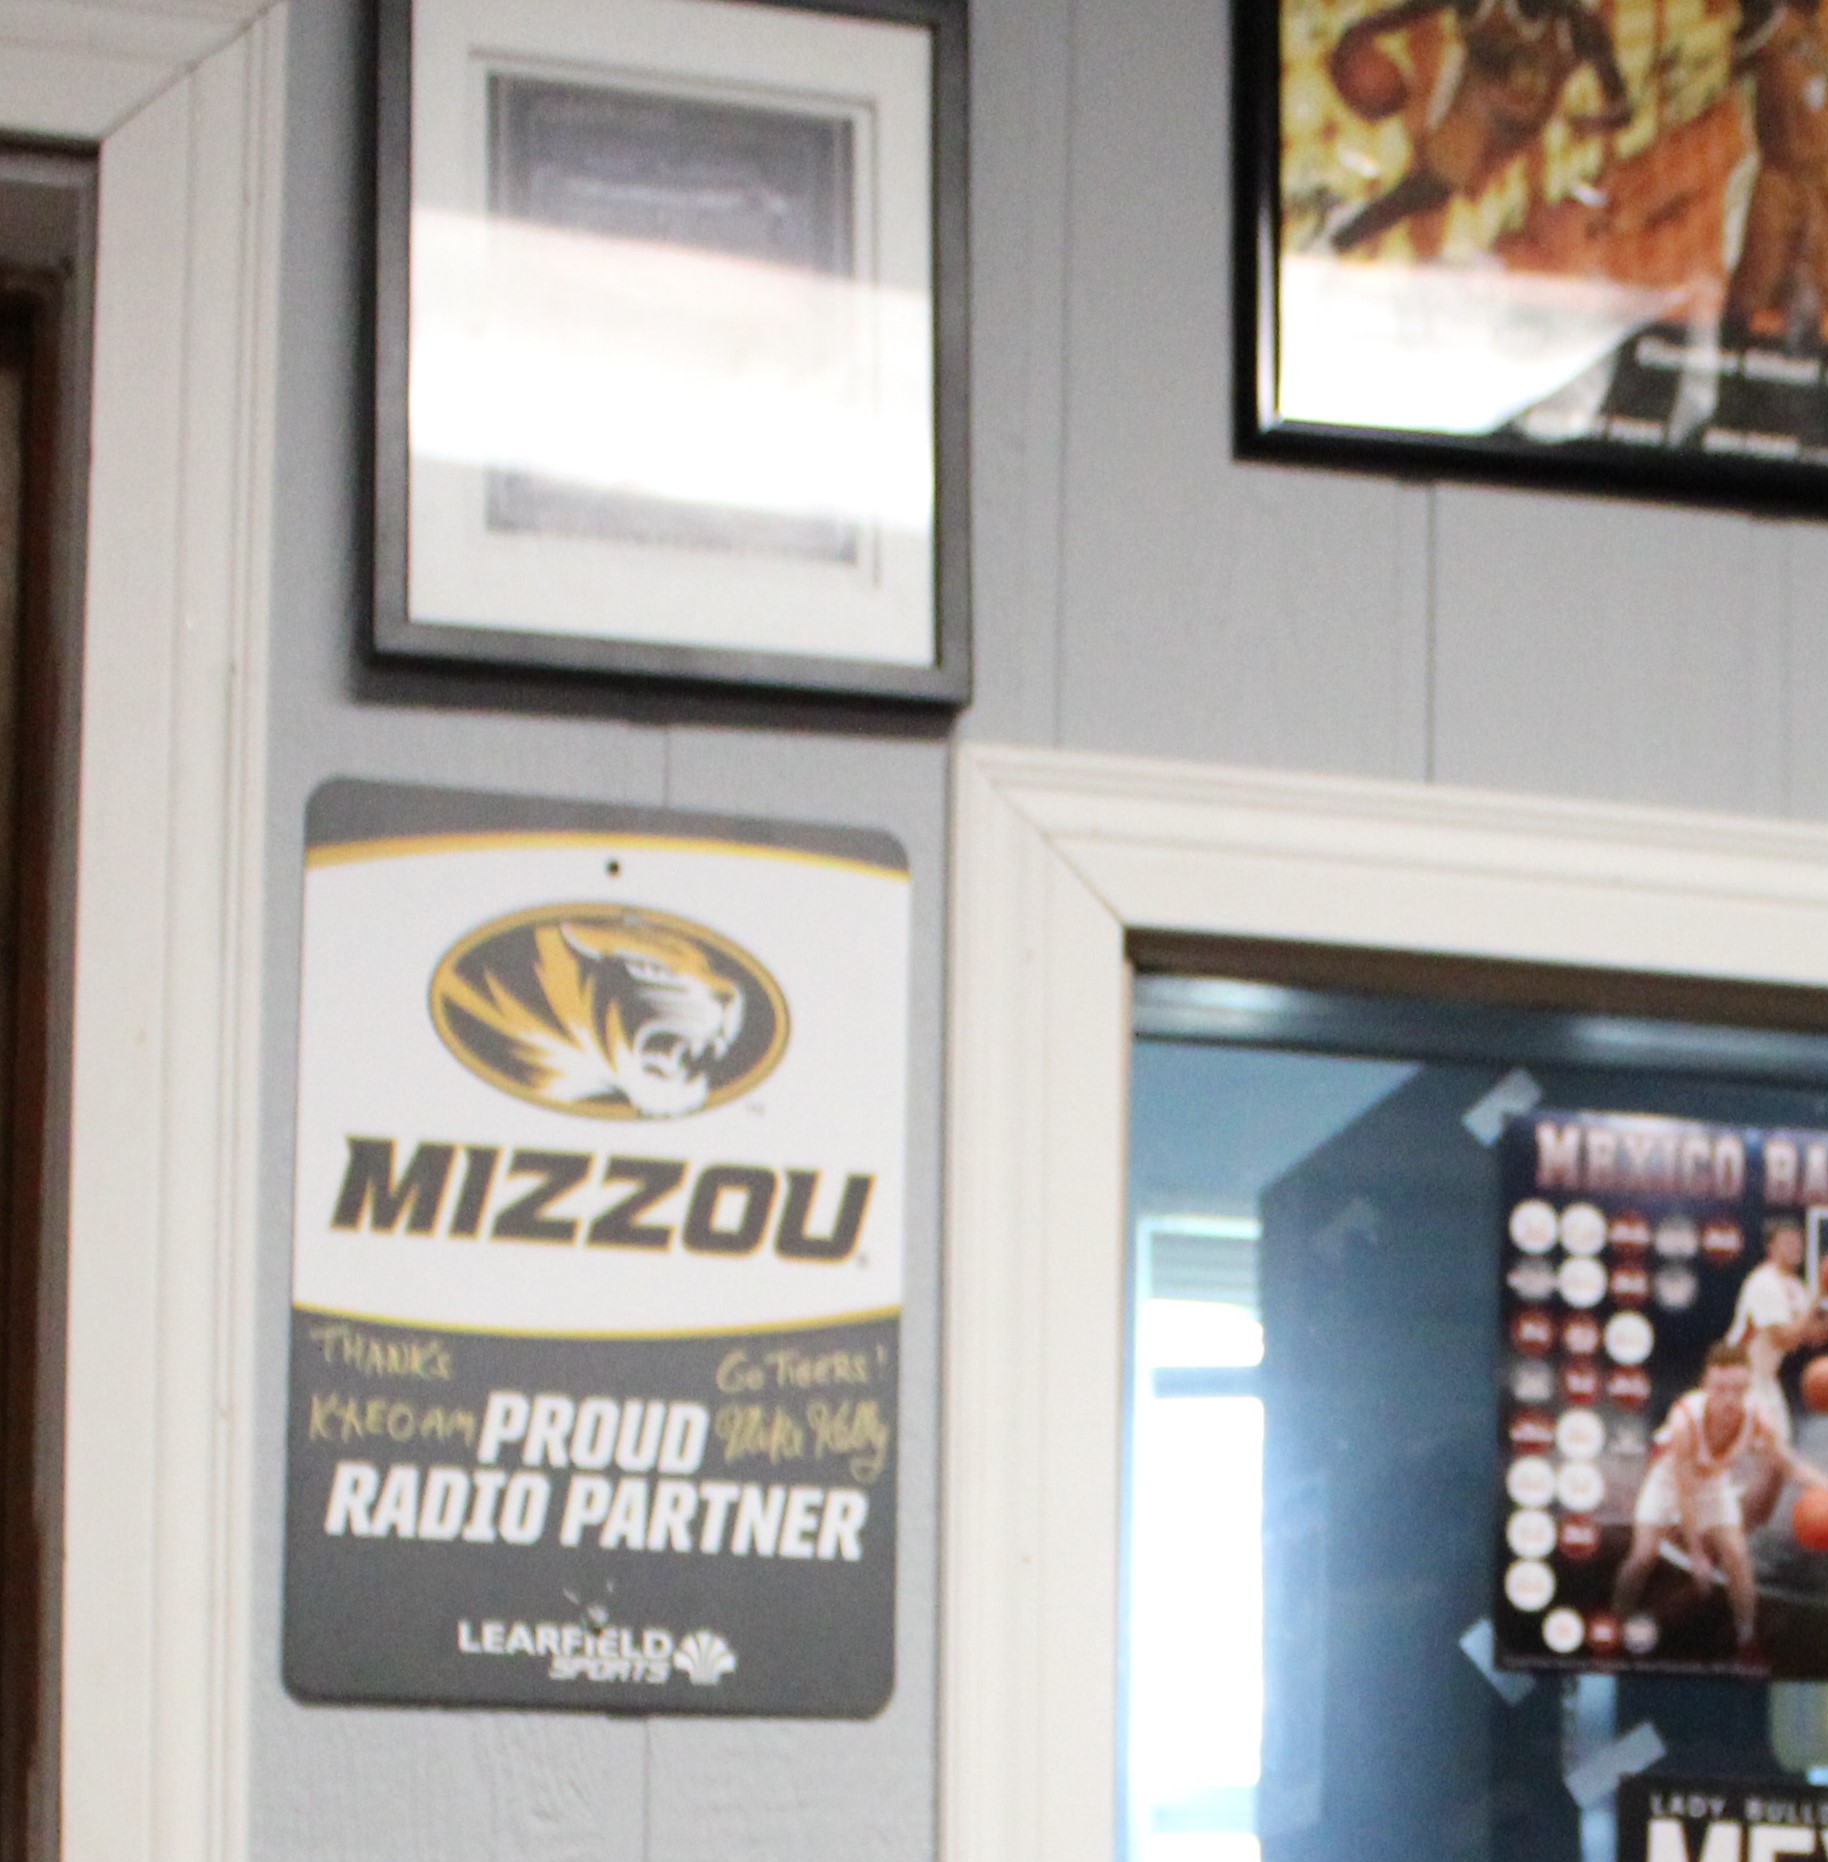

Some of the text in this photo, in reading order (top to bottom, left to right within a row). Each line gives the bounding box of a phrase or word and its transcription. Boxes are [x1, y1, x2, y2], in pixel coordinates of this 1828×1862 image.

[1534, 1120, 1746, 1198] MEXICO
[330, 1134, 878, 1264] MIZZOU
[478, 1389, 709, 1475] PROUD
[324, 1461, 868, 1563] RADIO PARTNER
[457, 1619, 675, 1659] LEARFIELD
[548, 1655, 673, 1685] SPORTS
[1650, 1794, 1728, 1819] LADY
